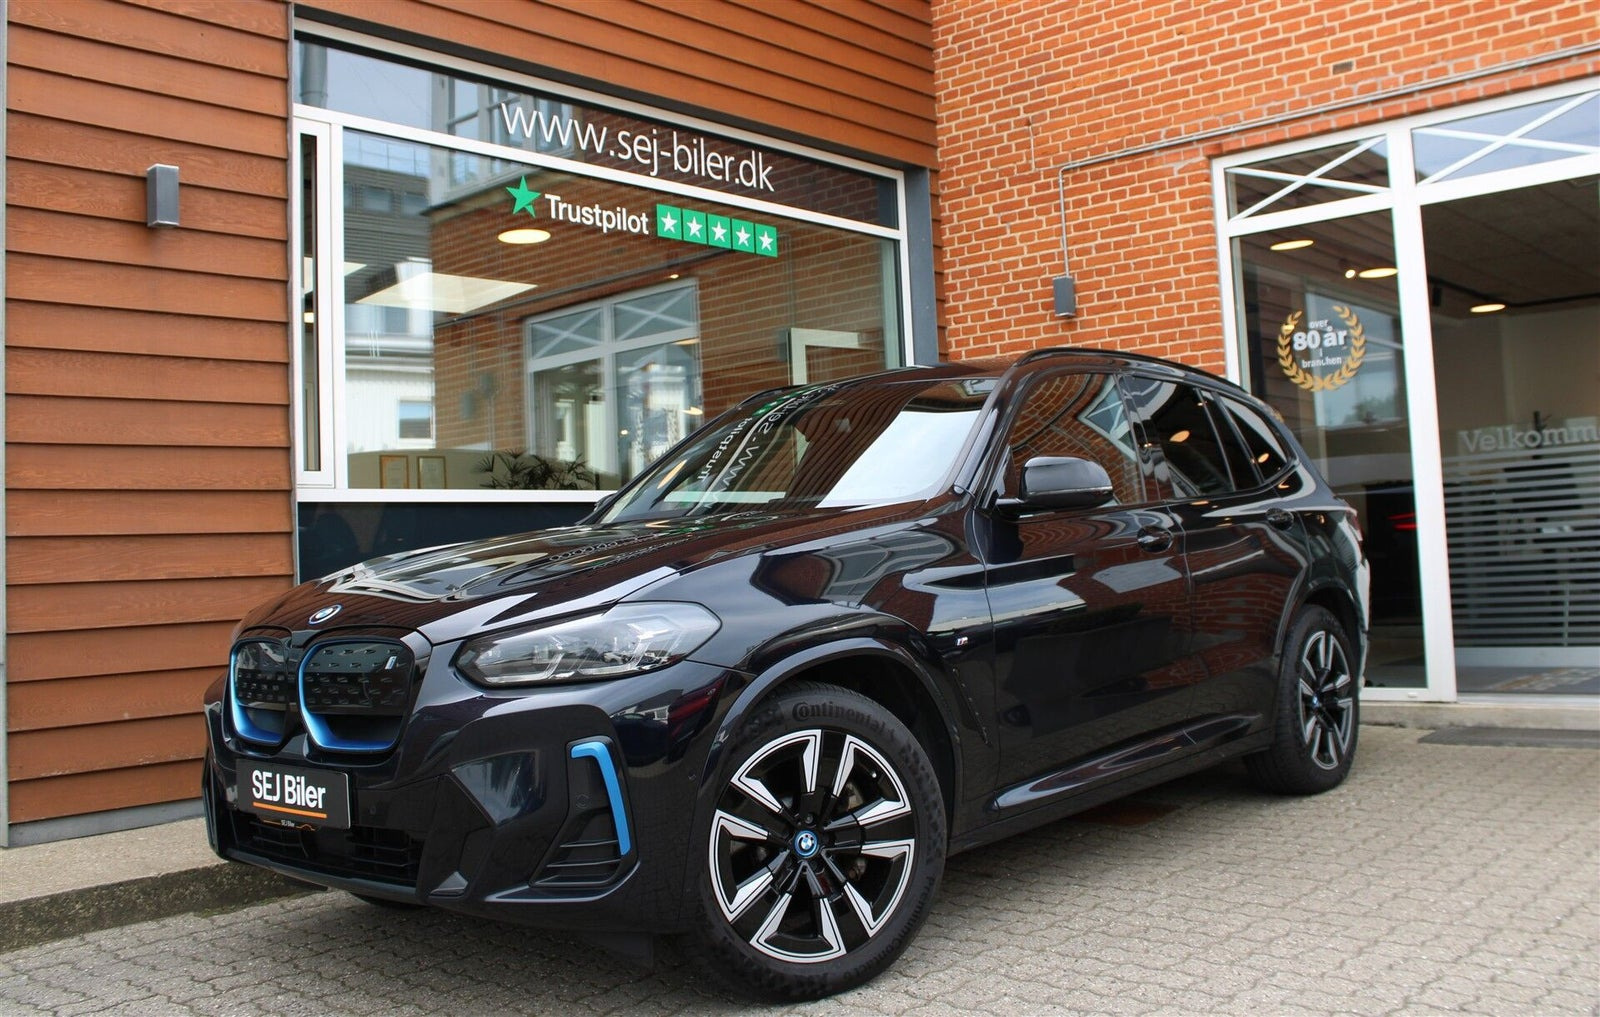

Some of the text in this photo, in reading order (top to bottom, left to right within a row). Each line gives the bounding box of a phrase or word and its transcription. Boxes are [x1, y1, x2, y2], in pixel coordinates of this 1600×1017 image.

[501, 103, 775, 192] www.sej-biler.dk
[545, 193, 649, 235] Trustpilot
[1293, 325, 1347, 351] 80 år
[1308, 319, 1329, 329] over
[1301, 356, 1342, 368] branchen
[1458, 424, 1600, 453] Velkomm
[792, 701, 886, 733] Continental
[252, 769, 326, 809] SEJ Biler
